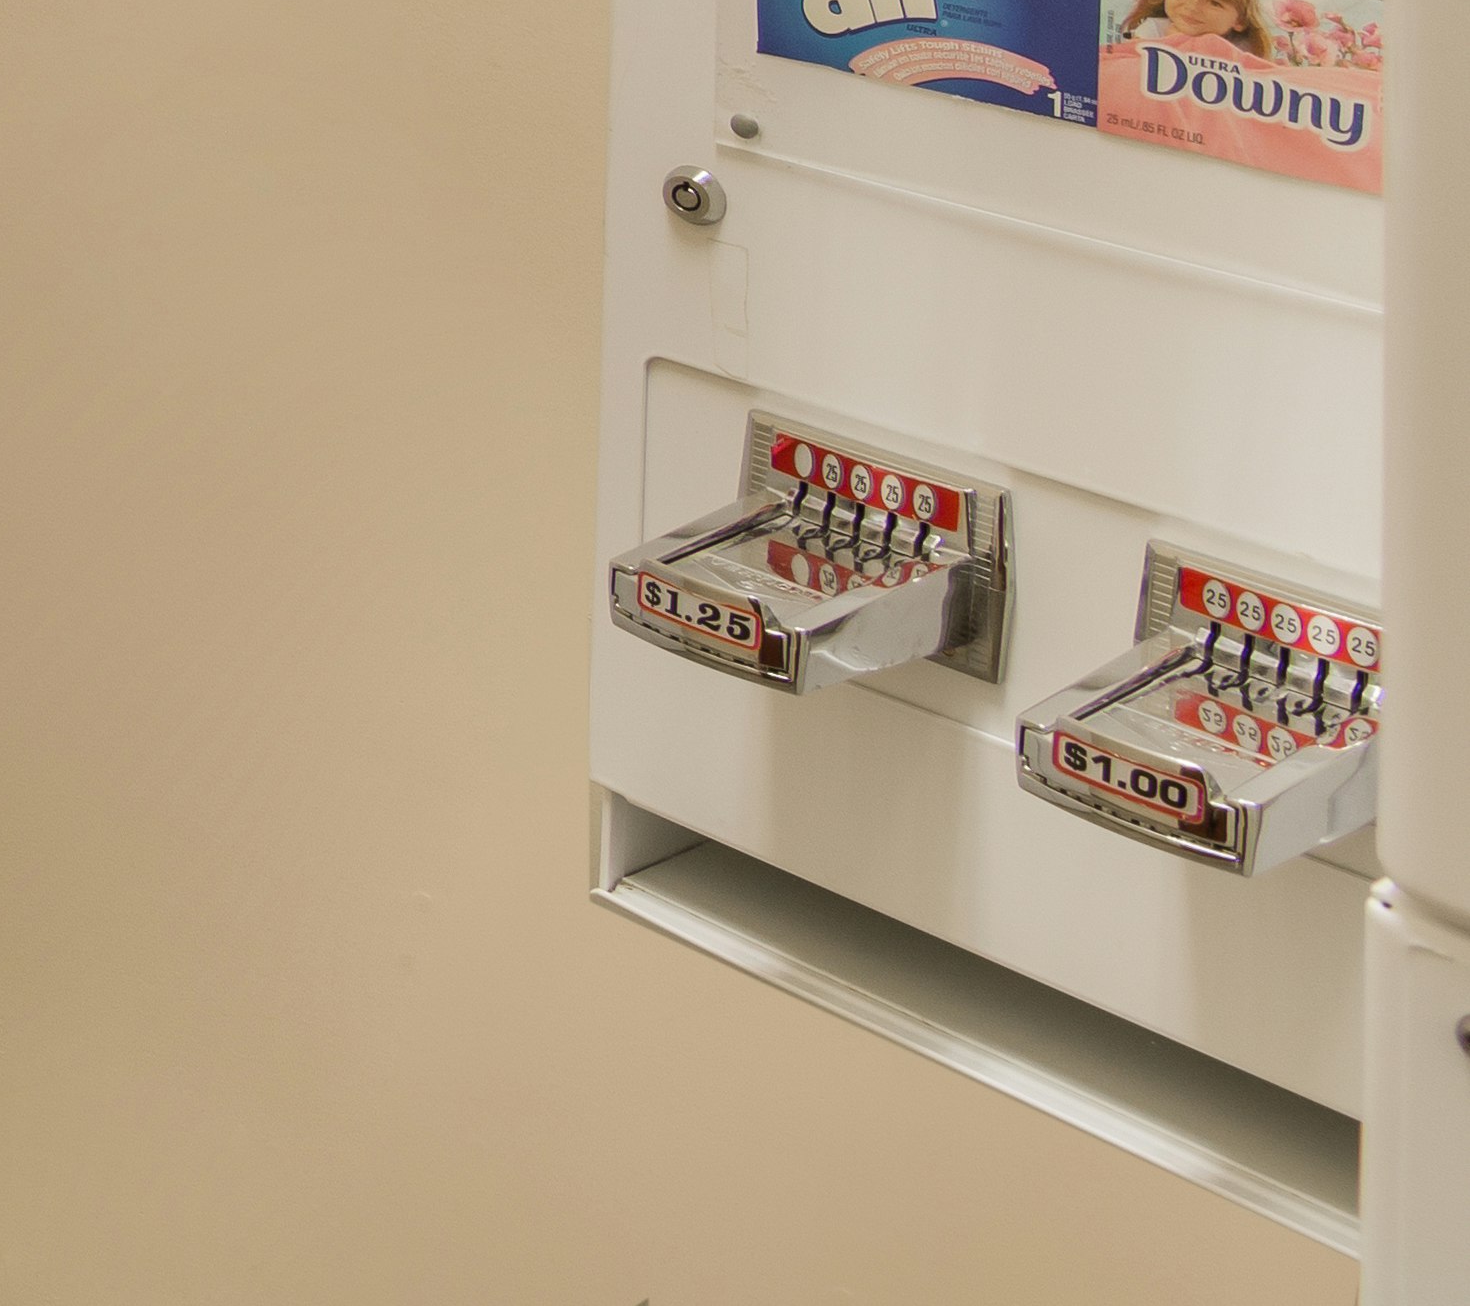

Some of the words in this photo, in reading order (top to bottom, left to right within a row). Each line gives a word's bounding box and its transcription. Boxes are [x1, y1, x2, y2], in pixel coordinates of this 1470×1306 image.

[906, 24, 937, 36] ULTRA
[860, 50, 890, 69] Safely
[892, 42, 918, 55] Lifts
[920, 41, 959, 51] Tough
[962, 42, 1003, 58] Stains
[1188, 55, 1240, 74] ULTRA
[1047, 91, 1062, 118] 1
[1142, 46, 1365, 146] Downy
[1106, 113, 1118, 125] 25
[1157, 123, 1169, 136] FL
[1171, 128, 1186, 140] OZ
[825, 463, 838, 483] 25
[854, 474, 867, 494] 25
[886, 484, 899, 504] 25
[918, 494, 931, 514] 25
[1205, 587, 1228, 610] 25
[644, 580, 752, 642] $1.25
[1239, 600, 1262, 622] 25
[1273, 612, 1298, 634] 25
[1312, 624, 1337, 646] 25
[1351, 636, 1376, 657] 25
[1063, 740, 1188, 810] $1.00
